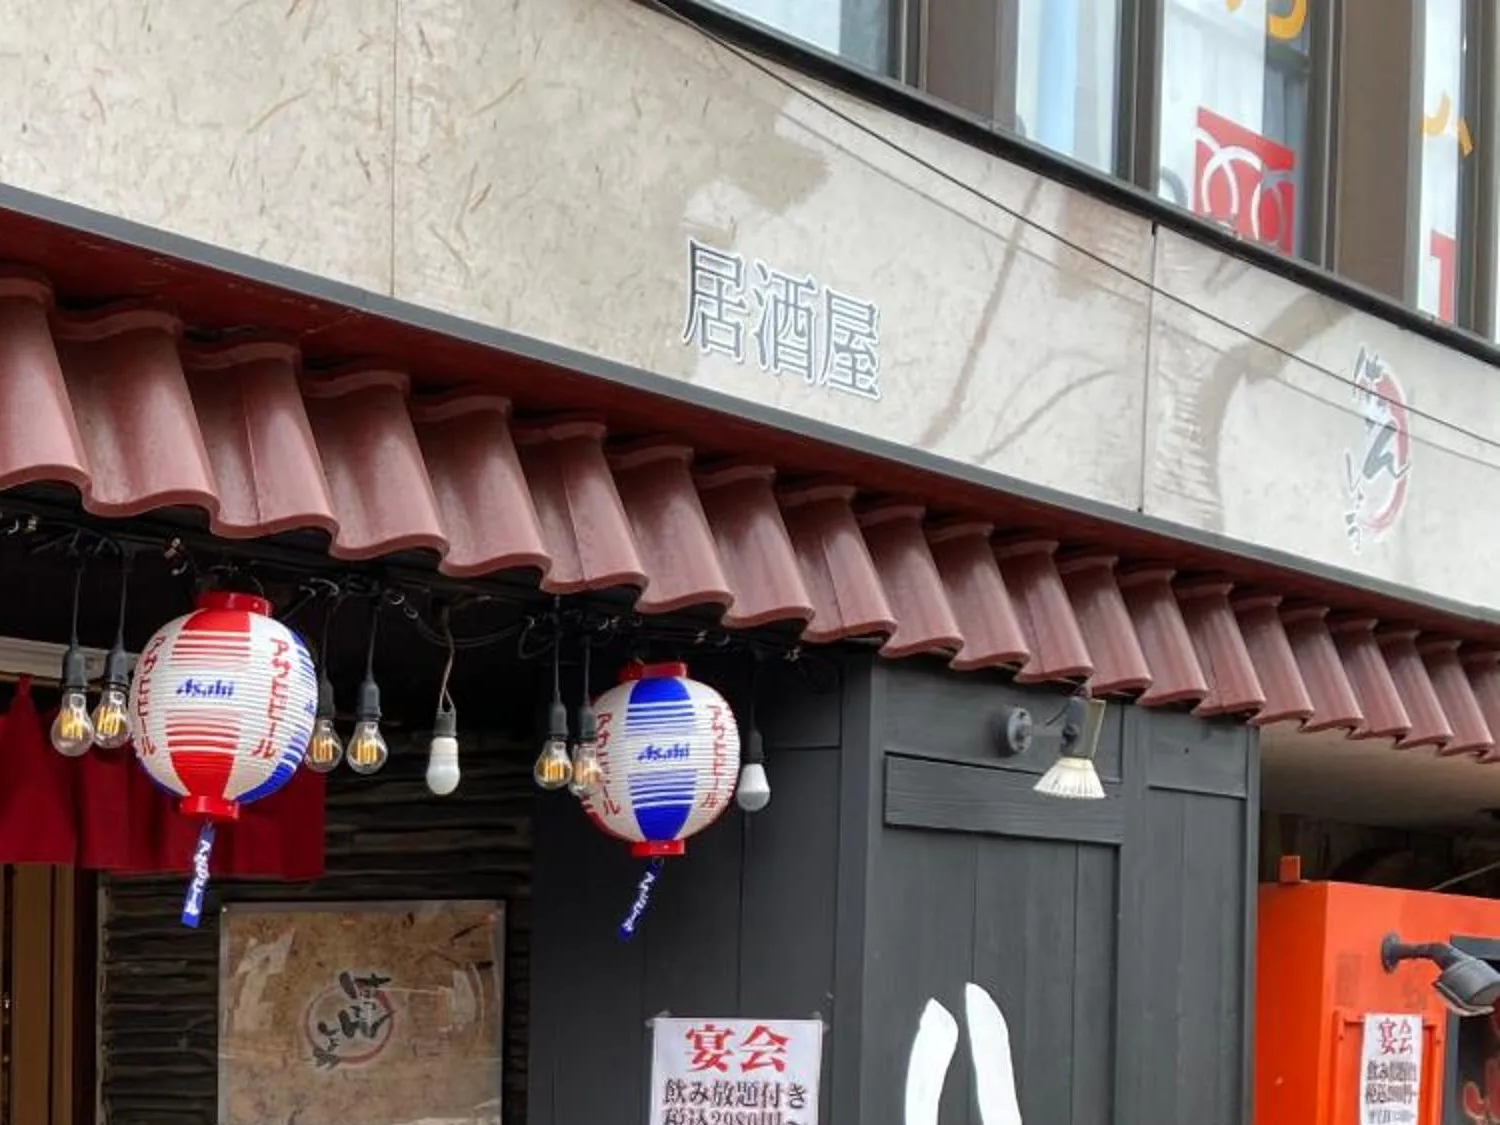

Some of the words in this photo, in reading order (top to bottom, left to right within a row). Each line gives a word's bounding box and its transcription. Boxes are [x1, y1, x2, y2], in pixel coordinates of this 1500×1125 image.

[682, 239, 880, 400] 居酒屋
[176, 678, 235, 699] Asahi
[251, 637, 291, 758] アサヒビール
[638, 743, 690, 762] Asahi
[684, 1023, 790, 1073] 宴会
[664, 1079, 807, 1110] 飲み放題付き
